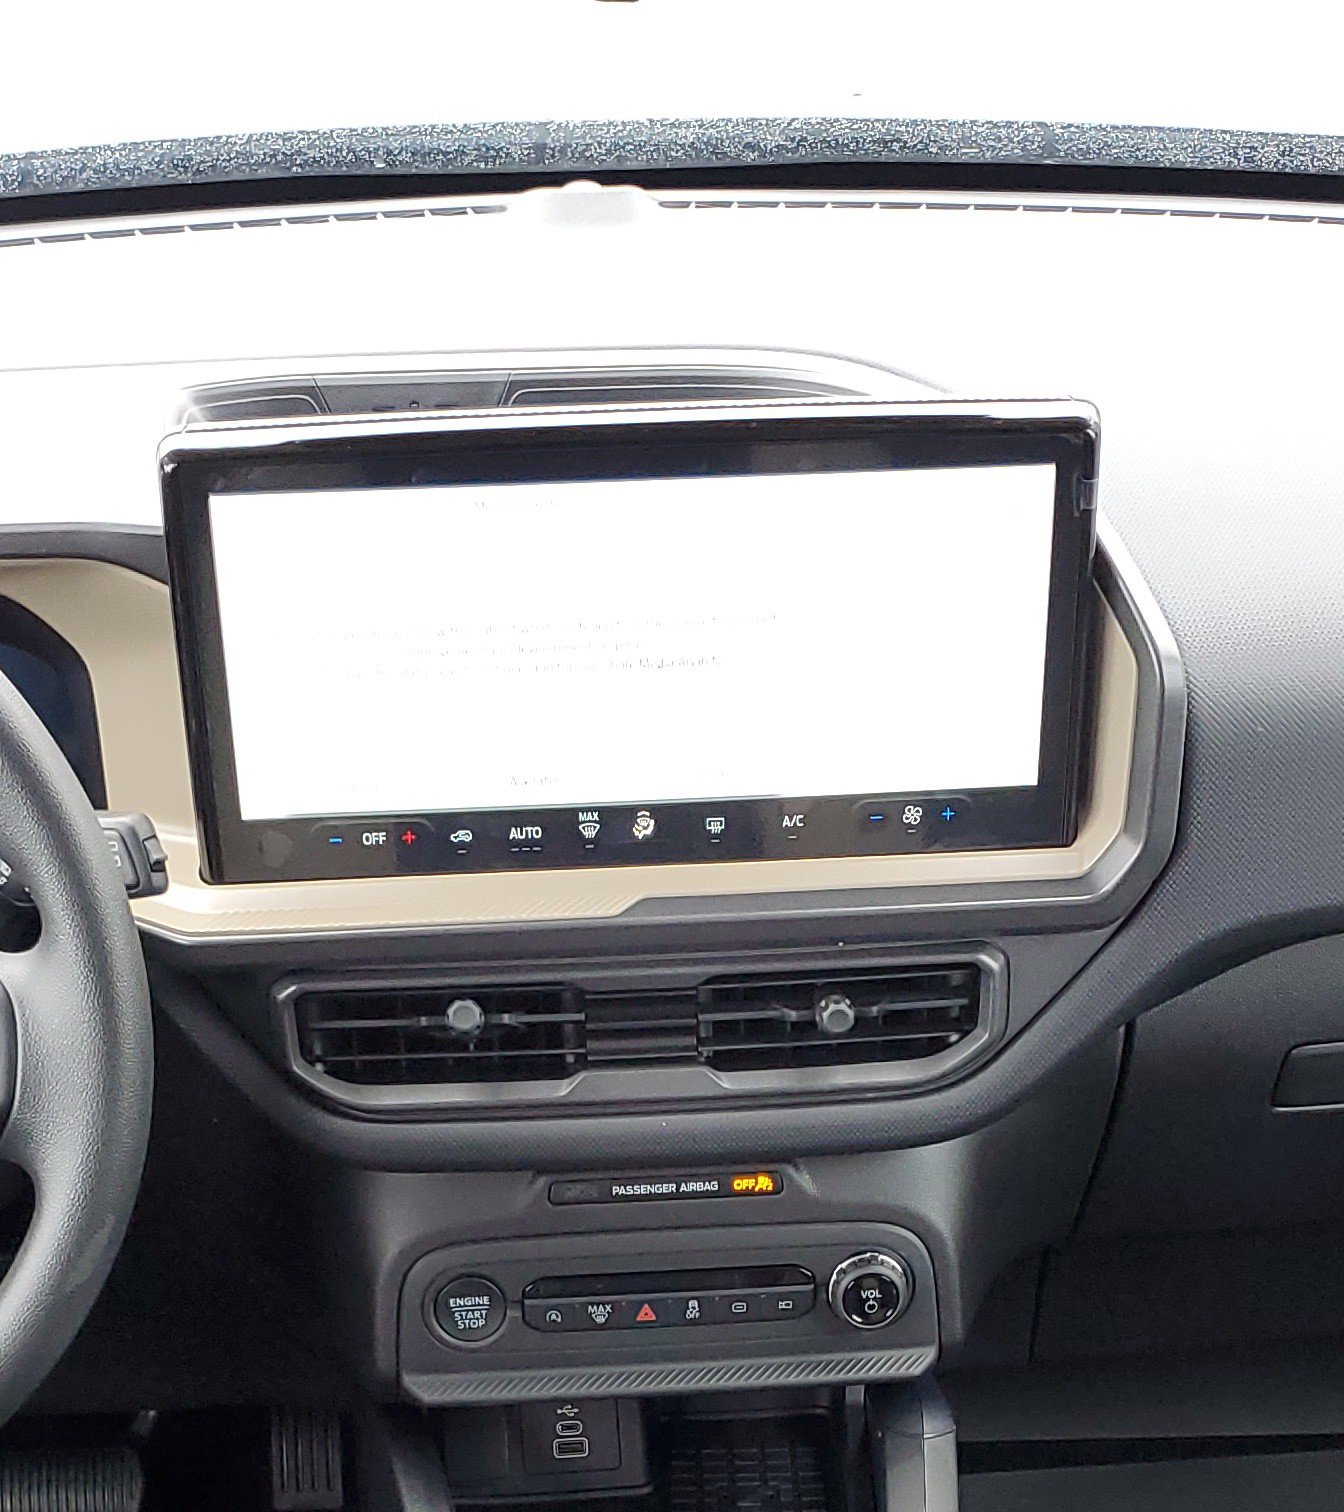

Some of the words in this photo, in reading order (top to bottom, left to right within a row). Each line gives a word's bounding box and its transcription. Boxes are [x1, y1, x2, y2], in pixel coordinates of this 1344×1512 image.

[578, 811, 599, 822] MAX
[781, 813, 805, 830] A/C
[362, 832, 387, 846] OFF
[509, 827, 542, 840] AUTO
[612, 1184, 676, 1197] PASSENGER
[679, 1180, 719, 1193] AIRBAG
[733, 1178, 756, 1191] OFF
[861, 1290, 882, 1299] VOL
[449, 1295, 490, 1307] ENGINE
[588, 1304, 612, 1314] MAX
[454, 1310, 487, 1321] START
[457, 1319, 486, 1330] STOP
